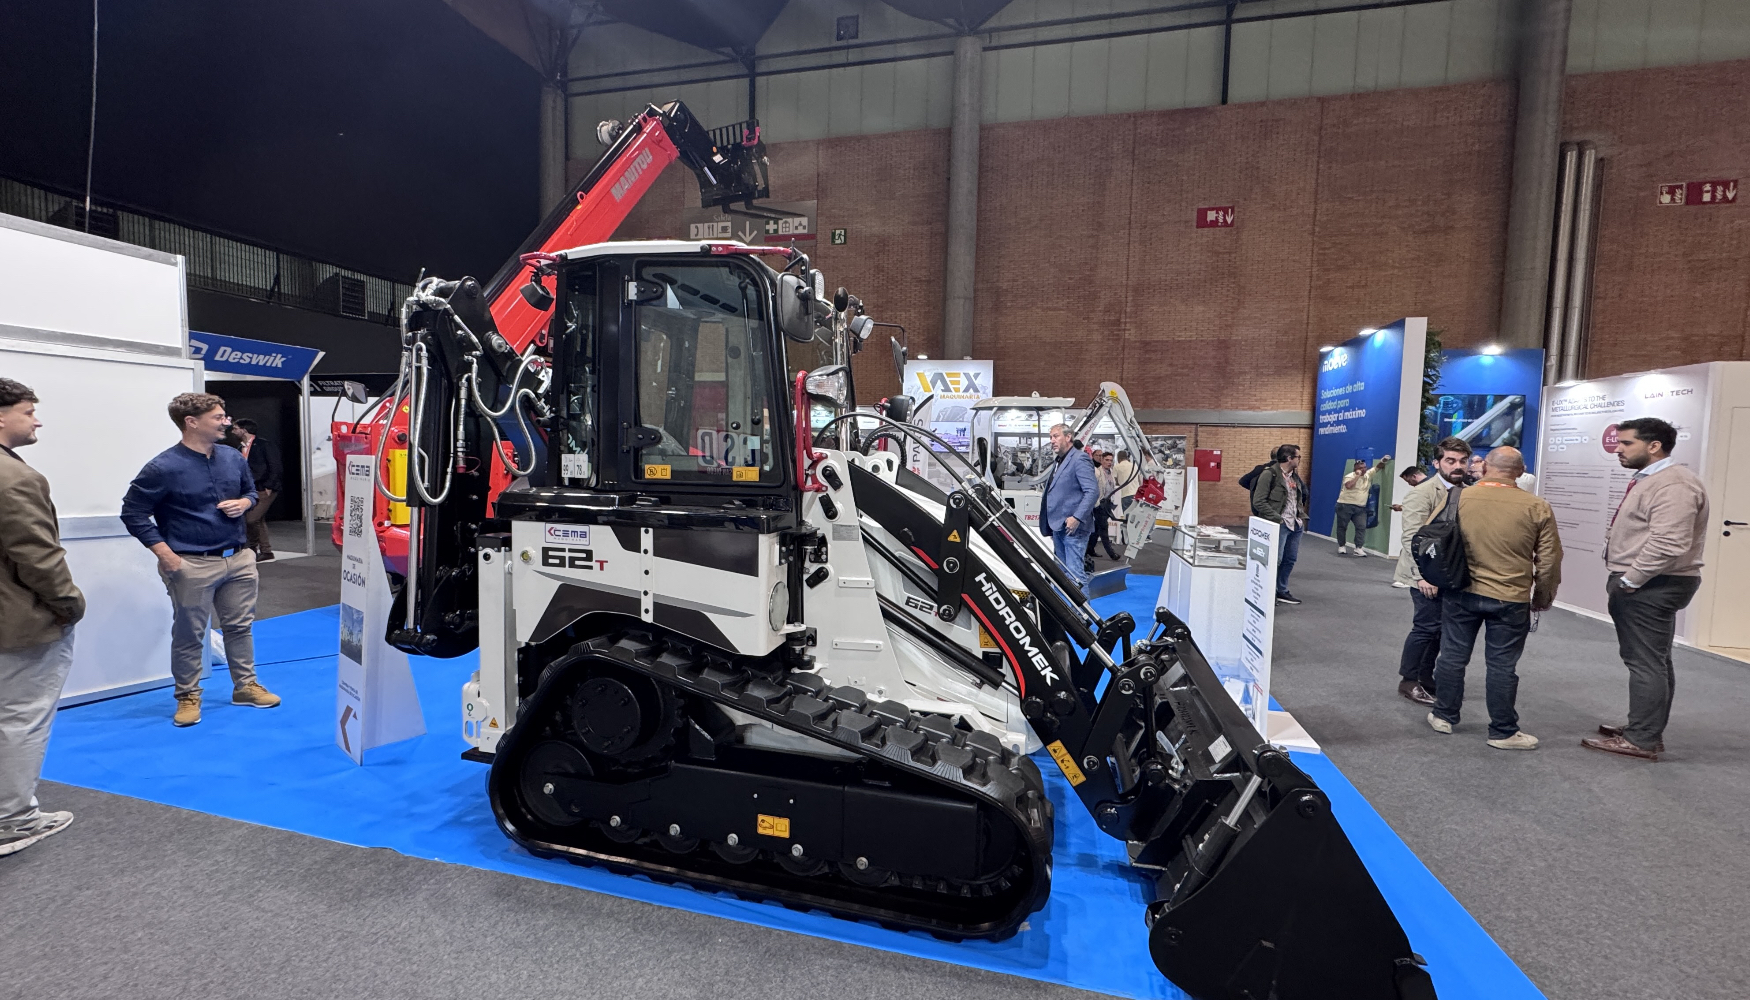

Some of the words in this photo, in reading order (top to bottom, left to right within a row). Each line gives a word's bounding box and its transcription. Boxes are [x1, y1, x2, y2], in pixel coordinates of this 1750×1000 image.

[610, 147, 653, 202] MANITOU
[214, 346, 287, 368] Deswik
[1323, 353, 1348, 372] moeve
[1321, 387, 1345, 399] Soluciones
[1346, 383, 1352, 392] de
[1353, 381, 1364, 391] alta
[1670, 388, 1693, 396] TECH
[1320, 412, 1338, 424] trabajar
[343, 569, 366, 588] OCASIÓN
